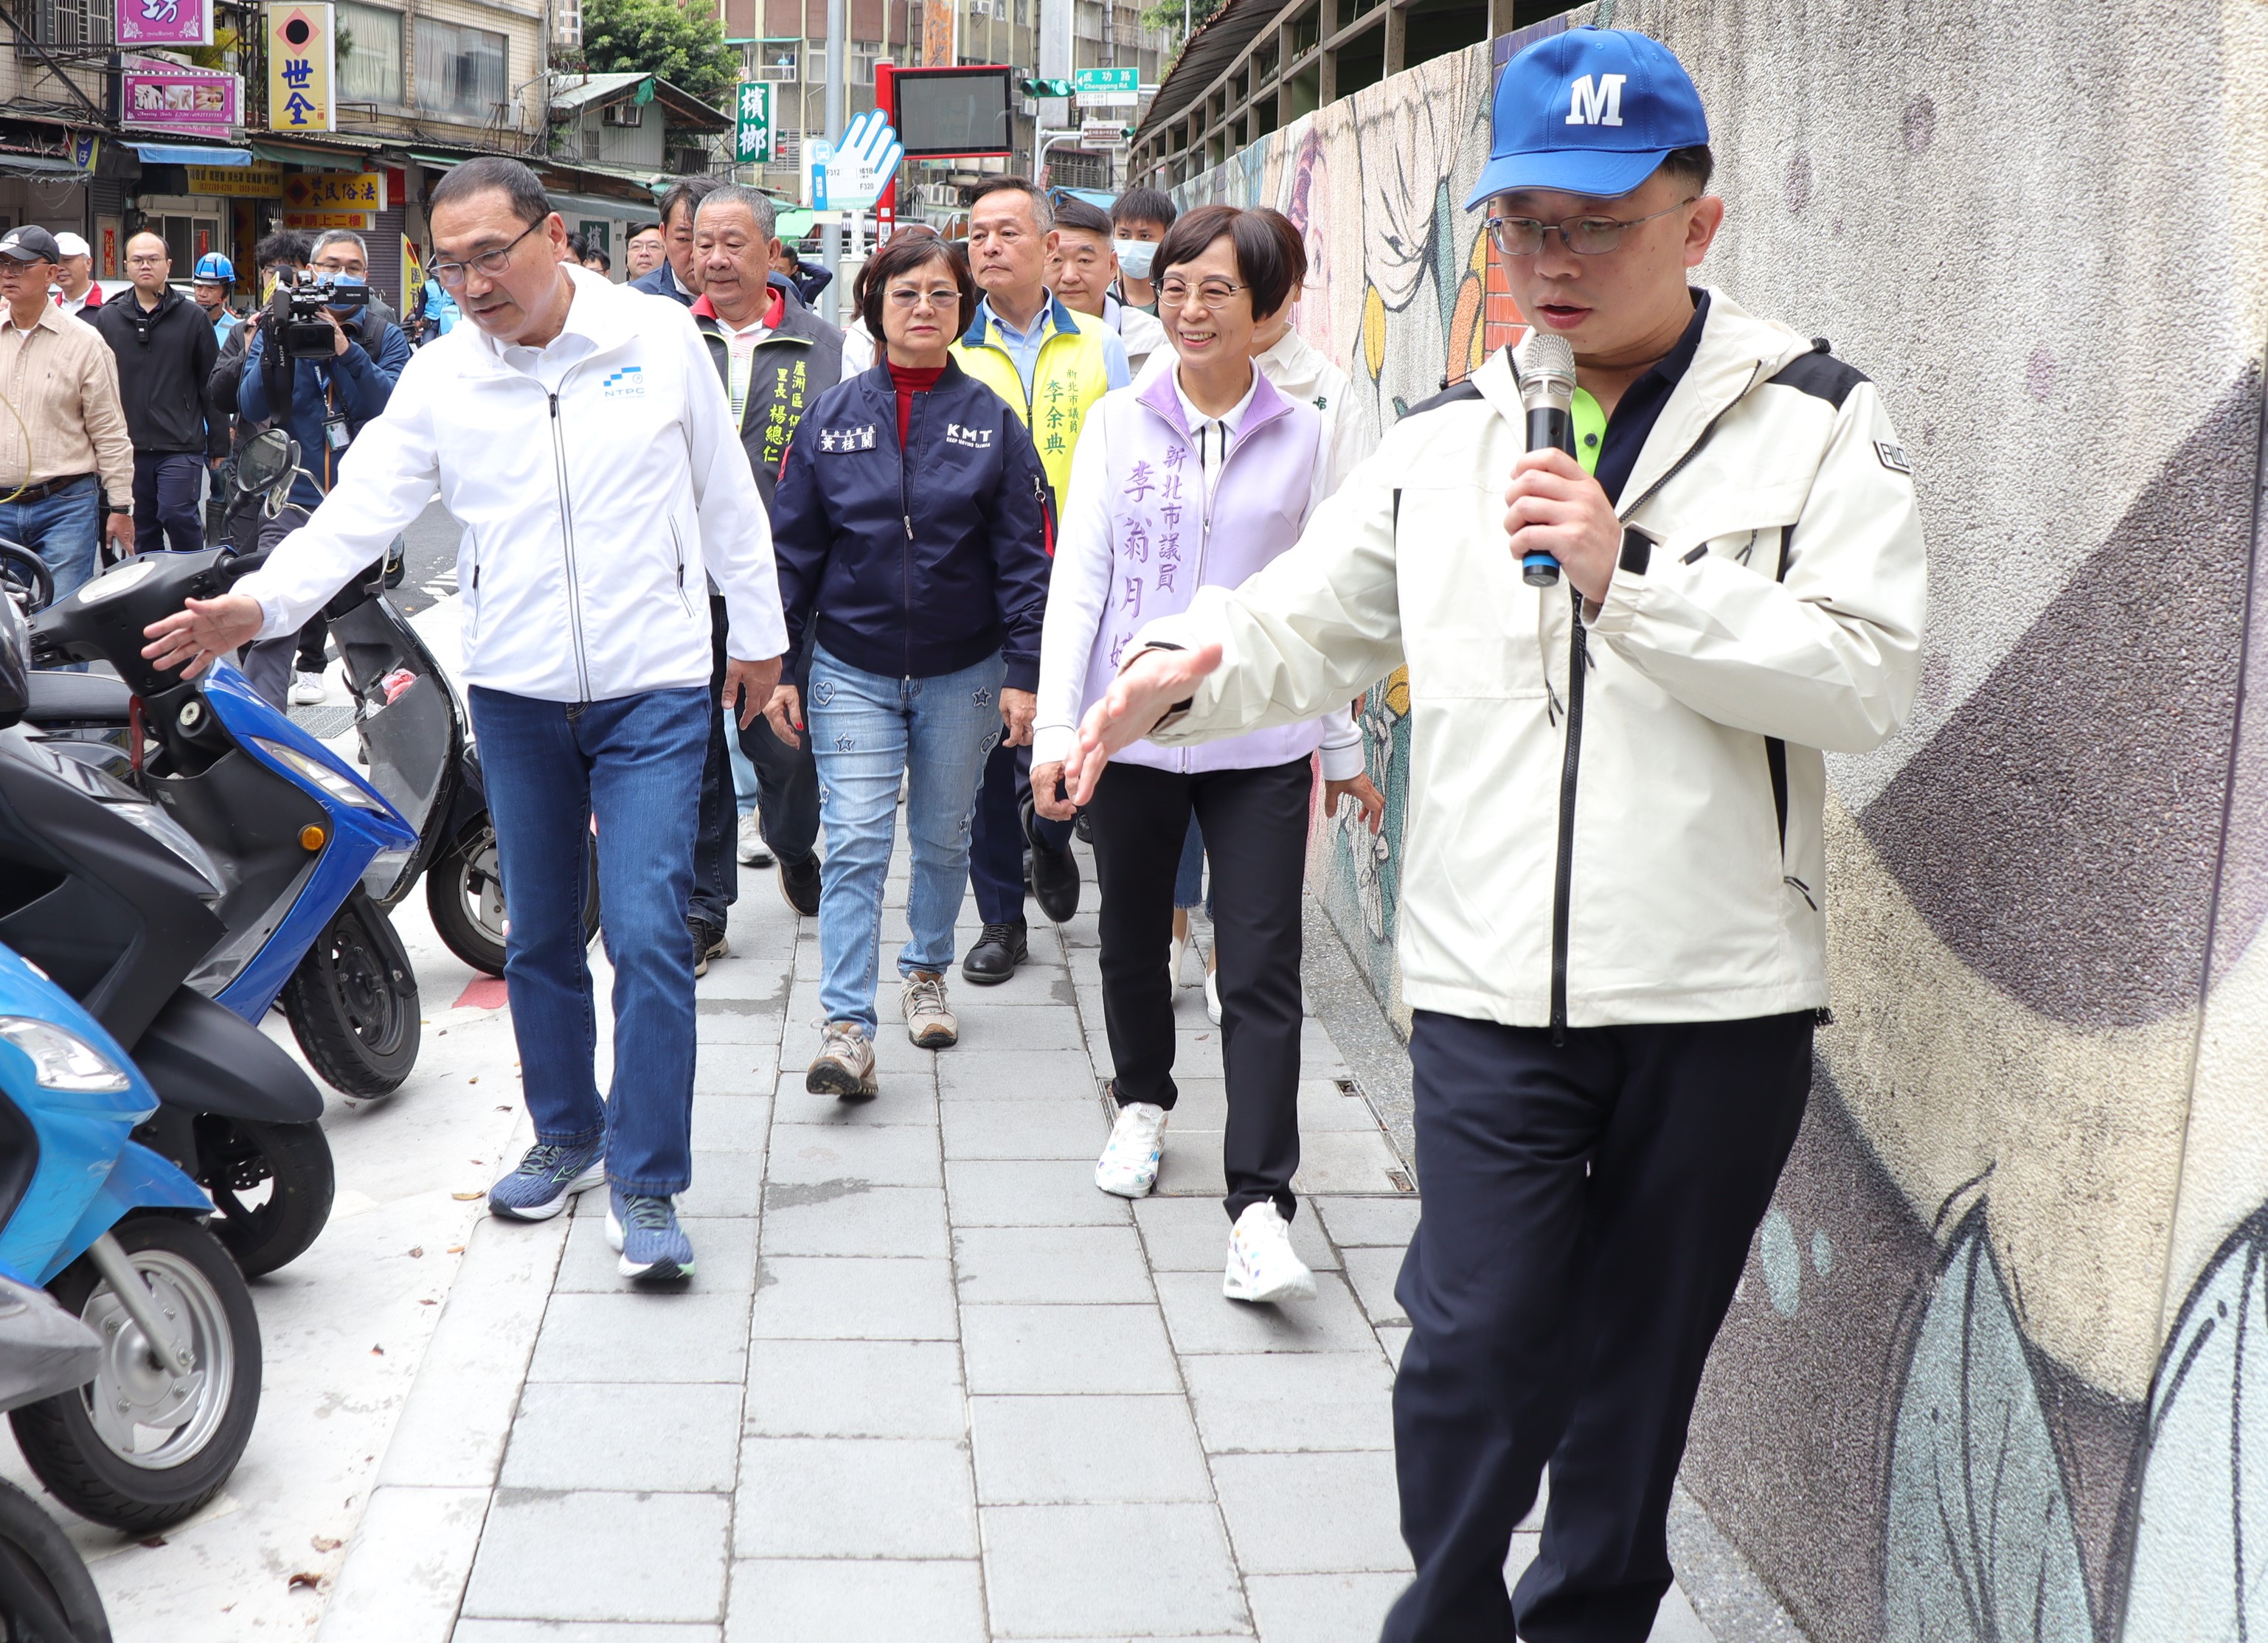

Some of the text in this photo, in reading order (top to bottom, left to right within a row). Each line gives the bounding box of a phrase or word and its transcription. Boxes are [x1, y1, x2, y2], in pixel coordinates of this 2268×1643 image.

[1083, 70, 1131, 82] 成功路
[281, 59, 316, 125] 世全
[1565, 73, 1627, 127] M
[738, 86, 767, 159] 檳榔
[78, 150, 89, 163] 仔
[311, 176, 376, 206] 世全 民俗法
[305, 214, 361, 227] 請上二樓
[604, 387, 645, 397] NTPC
[1067, 369, 1080, 434] 新北市議員
[763, 368, 788, 463] 里長 楊總仁
[1044, 380, 1067, 456] 李余典
[821, 432, 873, 452] 黃桂蘭
[947, 423, 993, 442] KMT
[958, 439, 974, 448] MOVING
[1155, 445, 1187, 594] 新北市議員
